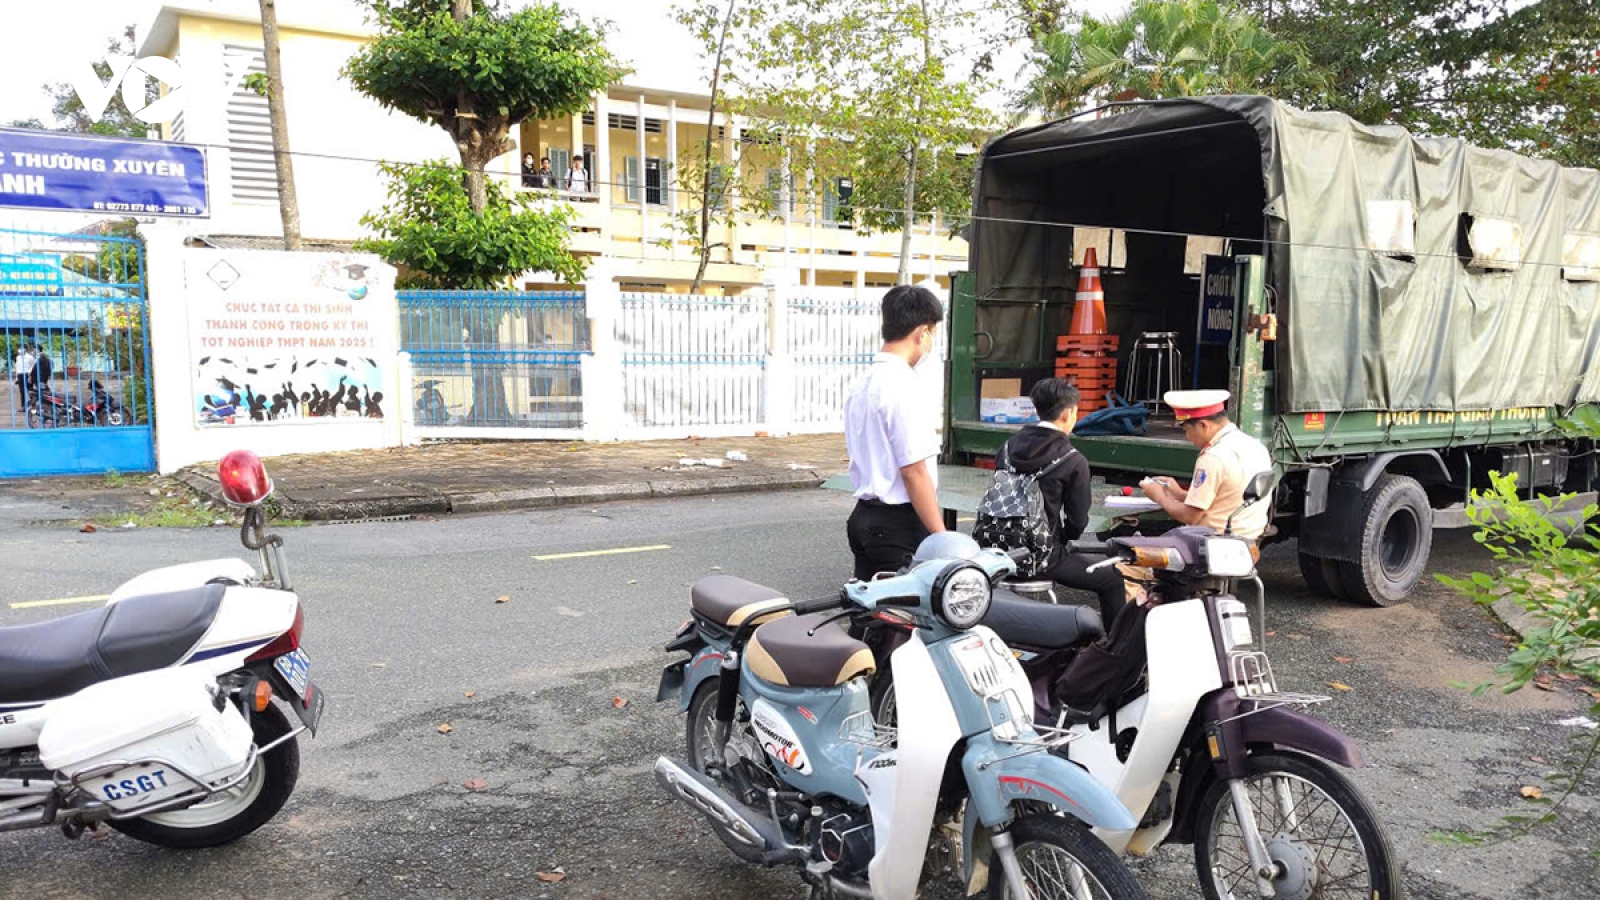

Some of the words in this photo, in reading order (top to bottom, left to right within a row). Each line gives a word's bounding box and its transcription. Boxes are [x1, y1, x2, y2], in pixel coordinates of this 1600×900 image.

[12, 151, 106, 173] THƯỜNG
[113, 157, 185, 177] XUYÊN
[0, 173, 46, 196] NH
[290, 320, 329, 331] TRONG
[277, 337, 305, 348] THPT
[339, 337, 367, 348] 2025
[103, 770, 169, 801] CSGT
